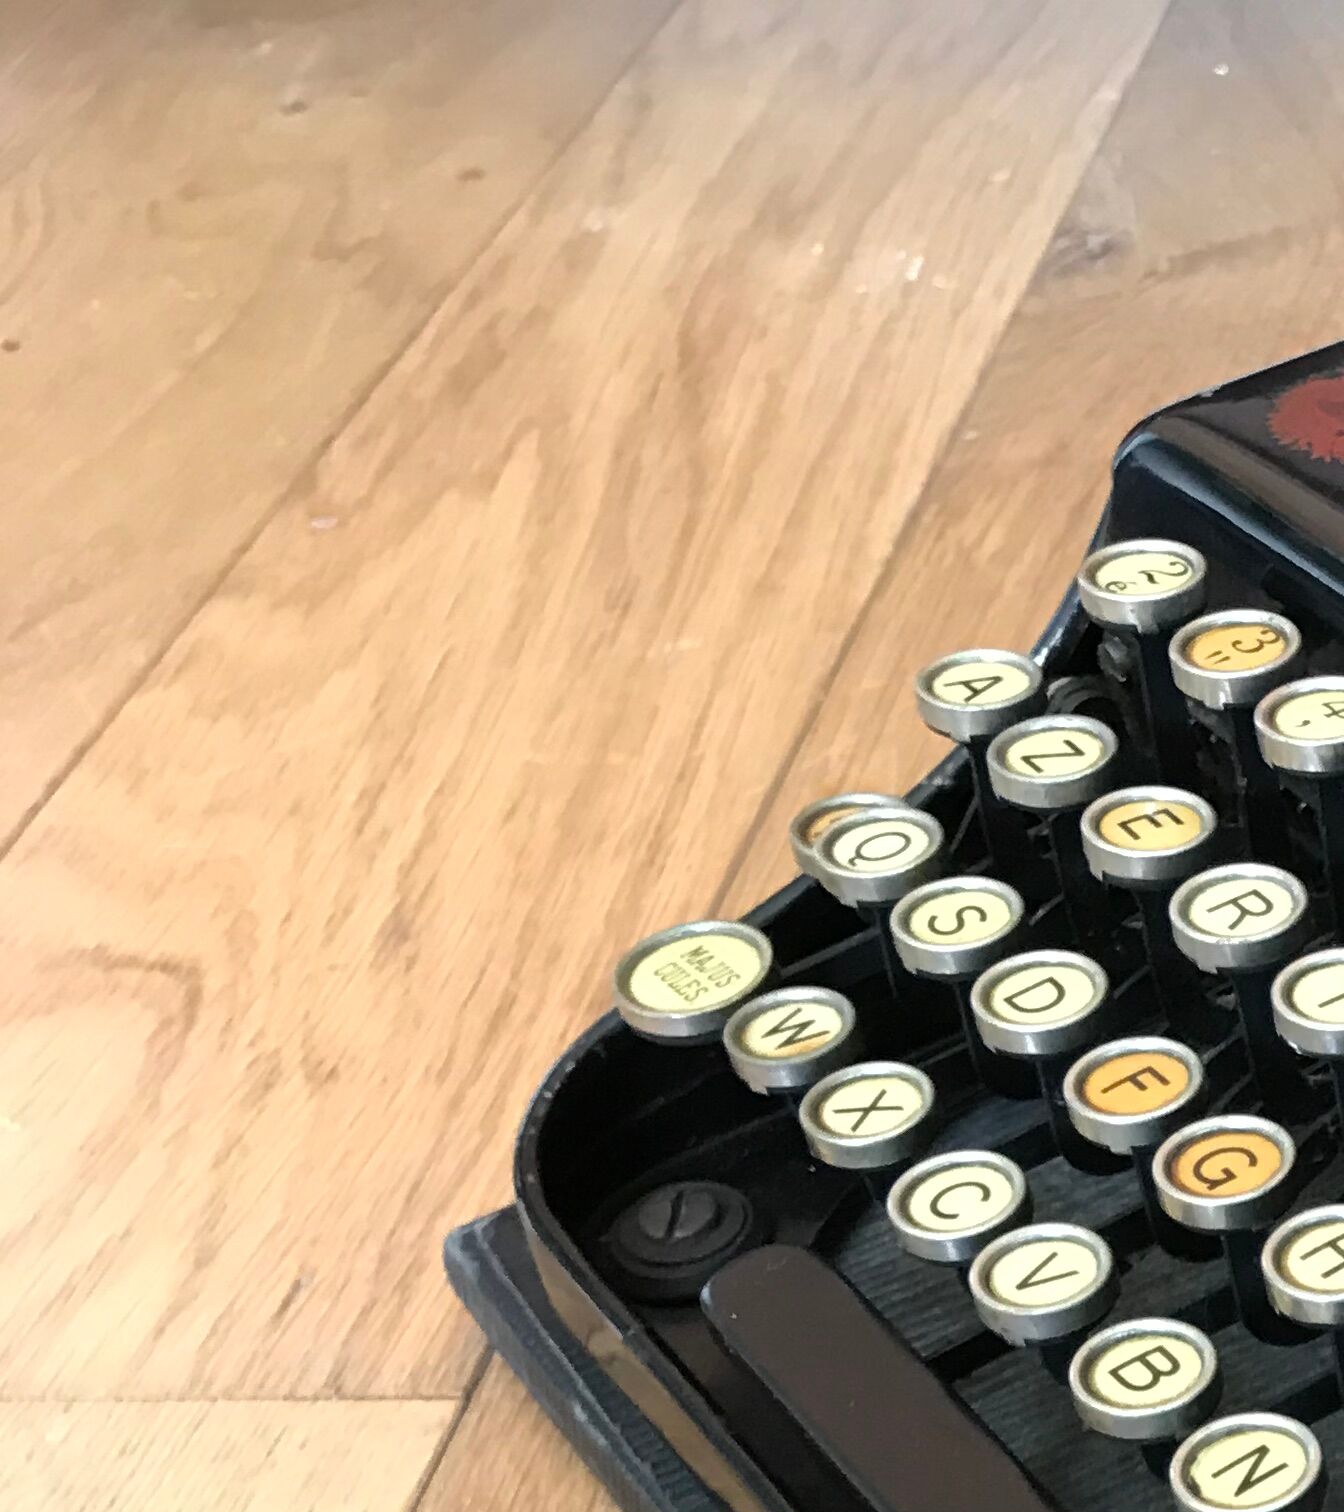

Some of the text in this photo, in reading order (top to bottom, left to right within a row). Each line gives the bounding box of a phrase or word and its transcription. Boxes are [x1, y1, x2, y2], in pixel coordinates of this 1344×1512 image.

[942, 674, 1005, 702] A
[1019, 740, 1086, 774] Z
[1116, 806, 1185, 841] E
[848, 831, 912, 867] Q
[926, 904, 988, 938] S
[1206, 887, 1274, 930] R
[1002, 975, 1068, 1014] D
[761, 1006, 831, 1052] W
[1099, 1065, 1171, 1095] F
[832, 1088, 905, 1132] X
[1191, 1146, 1259, 1191] G
[928, 1180, 992, 1221] C
[1014, 1251, 1080, 1292] V
[1108, 1344, 1182, 1393] B
[1210, 1443, 1290, 1498] N
